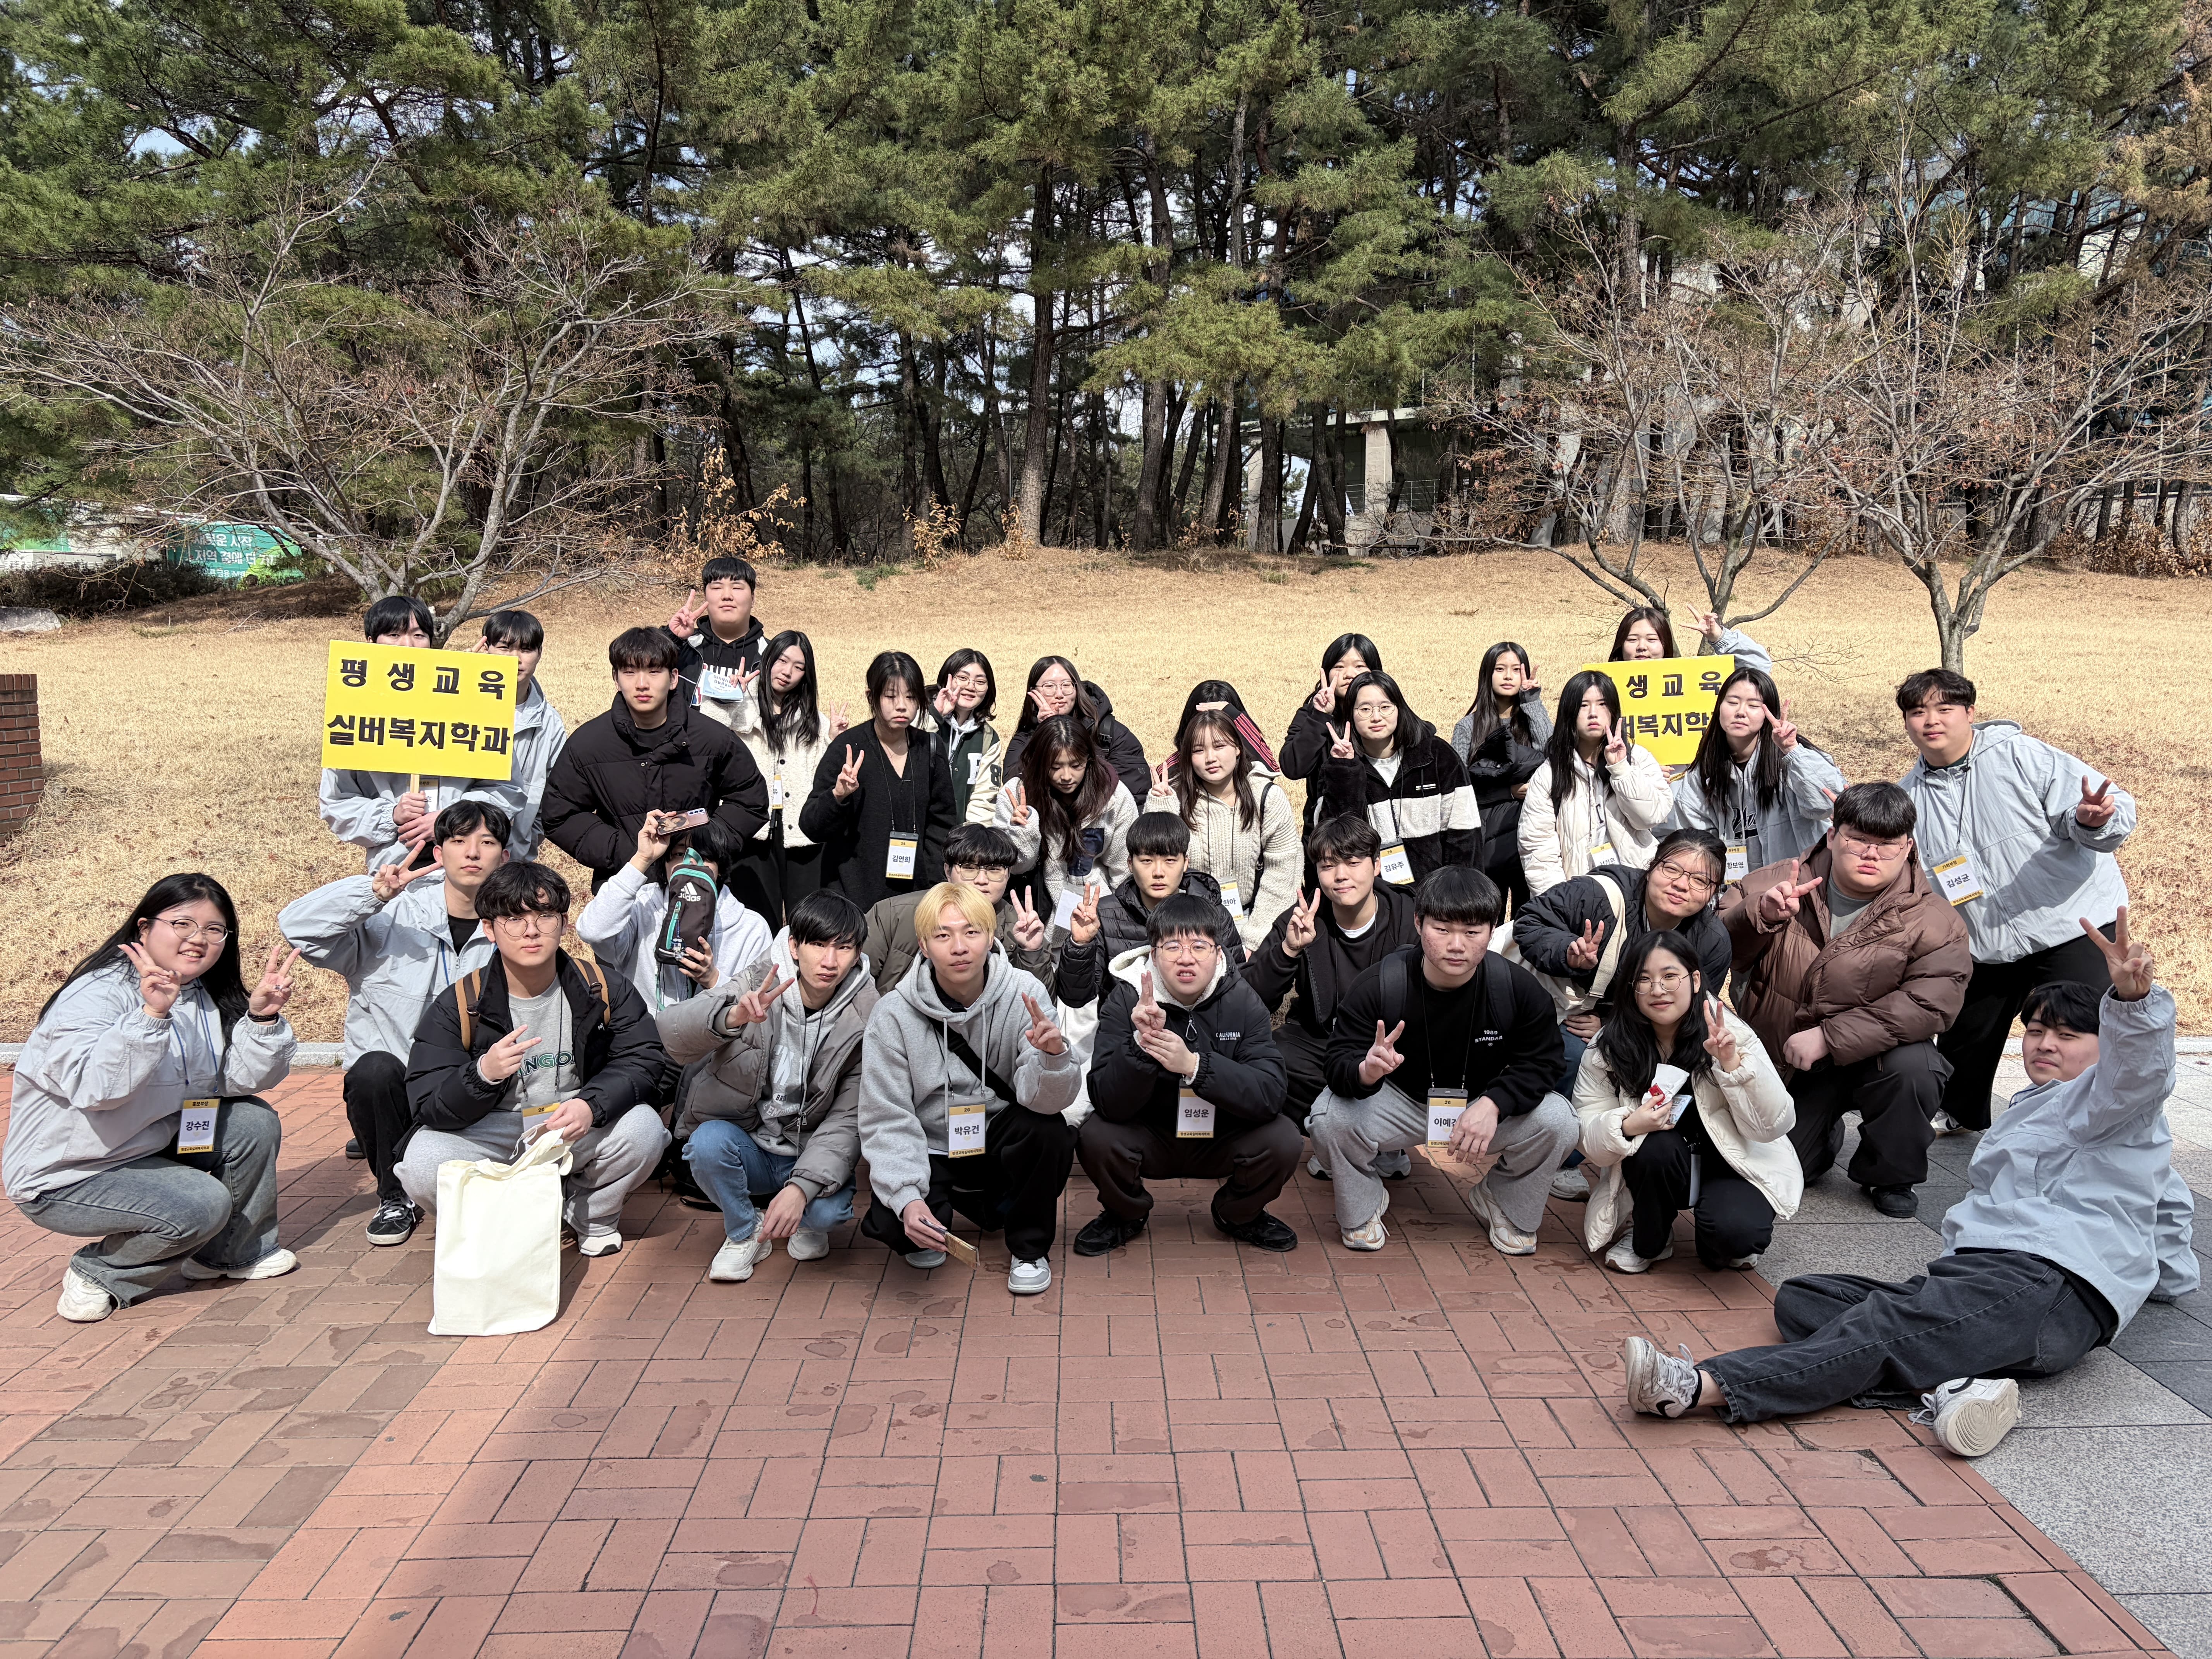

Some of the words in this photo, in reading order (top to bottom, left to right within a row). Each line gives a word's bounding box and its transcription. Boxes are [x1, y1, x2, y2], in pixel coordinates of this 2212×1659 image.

[230, 535, 252, 548] 시작
[327, 715, 510, 755] 실버복지학과
[892, 855, 910, 864] 김연희
[1384, 861, 1404, 872] 김유주
[1946, 873, 1970, 888] 김성균
[1184, 1109, 1209, 1118] 임성운
[186, 1120, 210, 1131] 강수진
[954, 1124, 979, 1136] 박유건
